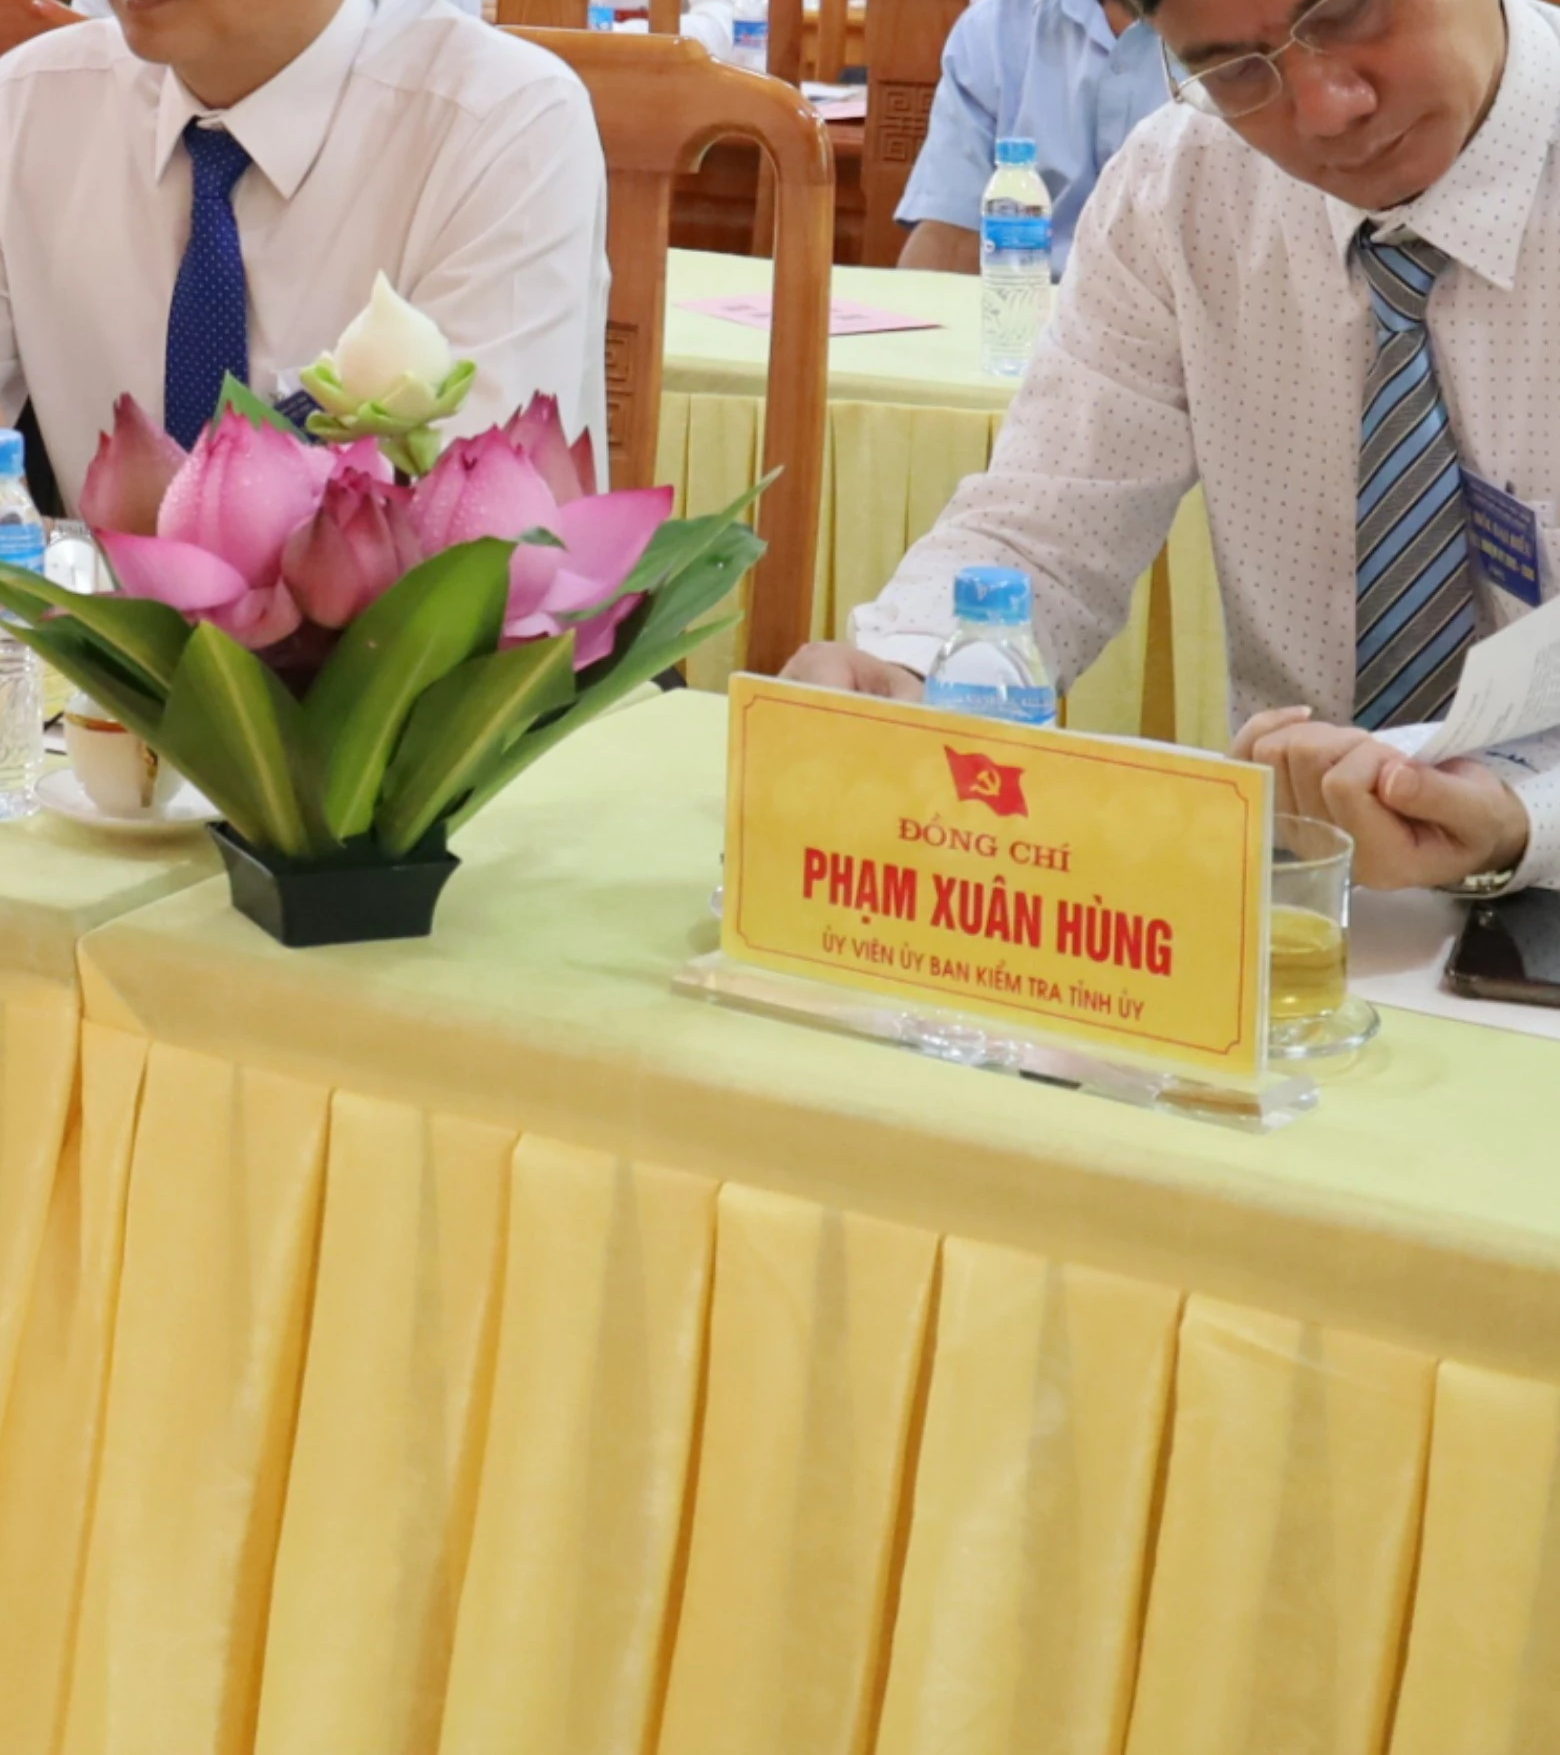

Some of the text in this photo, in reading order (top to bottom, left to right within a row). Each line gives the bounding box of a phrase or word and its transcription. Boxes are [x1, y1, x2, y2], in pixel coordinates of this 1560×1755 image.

[898, 813, 1072, 873] ĐỒNG CHÍ
[802, 847, 1173, 976] PHẠM XUÂN HÙNG
[822, 924, 1145, 1021] ỦY VIÊN ỦY BAN KIỂM TRA TỈNH ỦY
